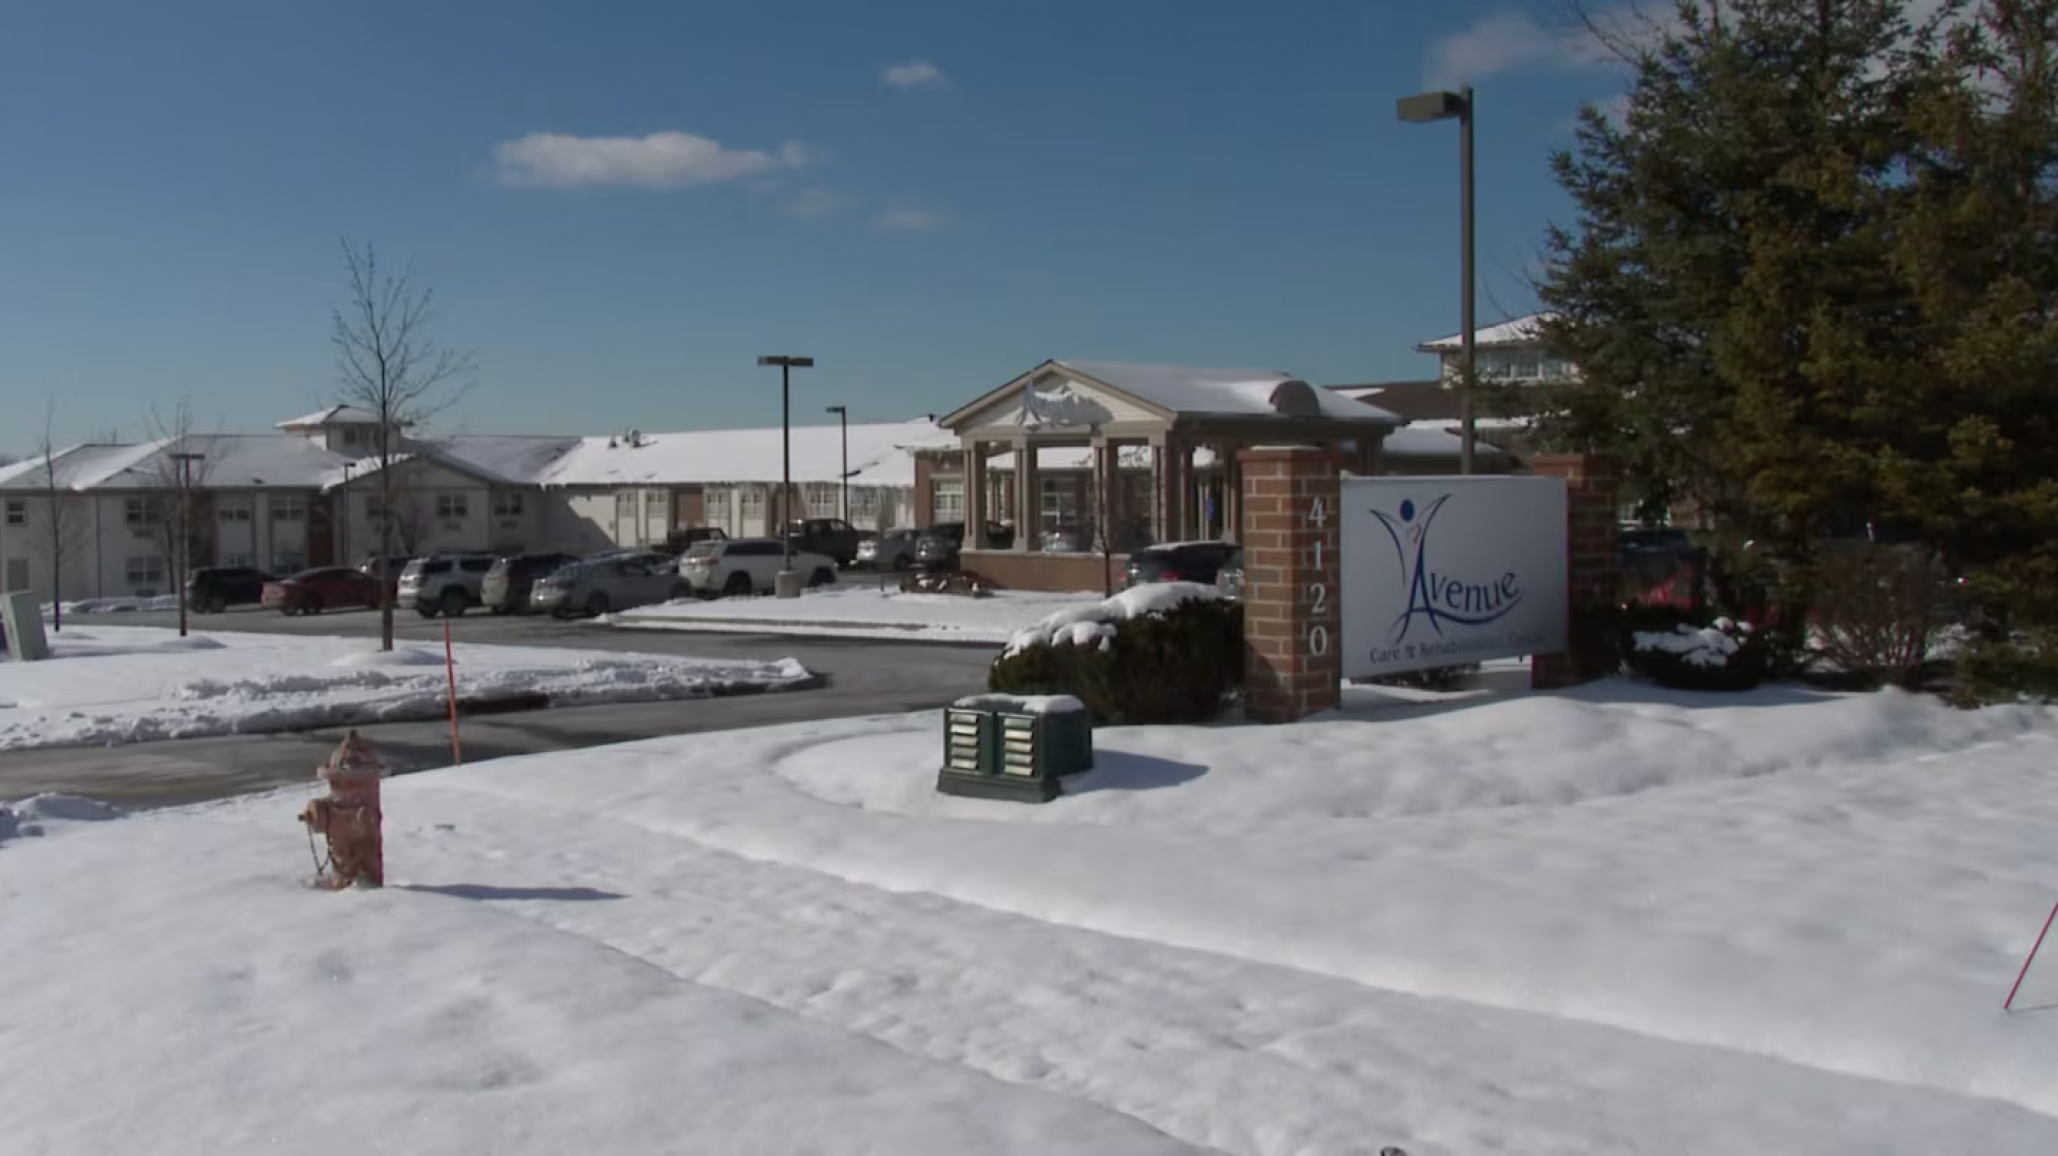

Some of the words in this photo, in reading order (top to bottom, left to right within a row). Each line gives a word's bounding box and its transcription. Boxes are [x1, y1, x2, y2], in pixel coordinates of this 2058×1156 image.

[1309, 497, 1328, 656] 4120
[1390, 495, 1522, 644] Avenue
[1369, 647, 1401, 664] Care
